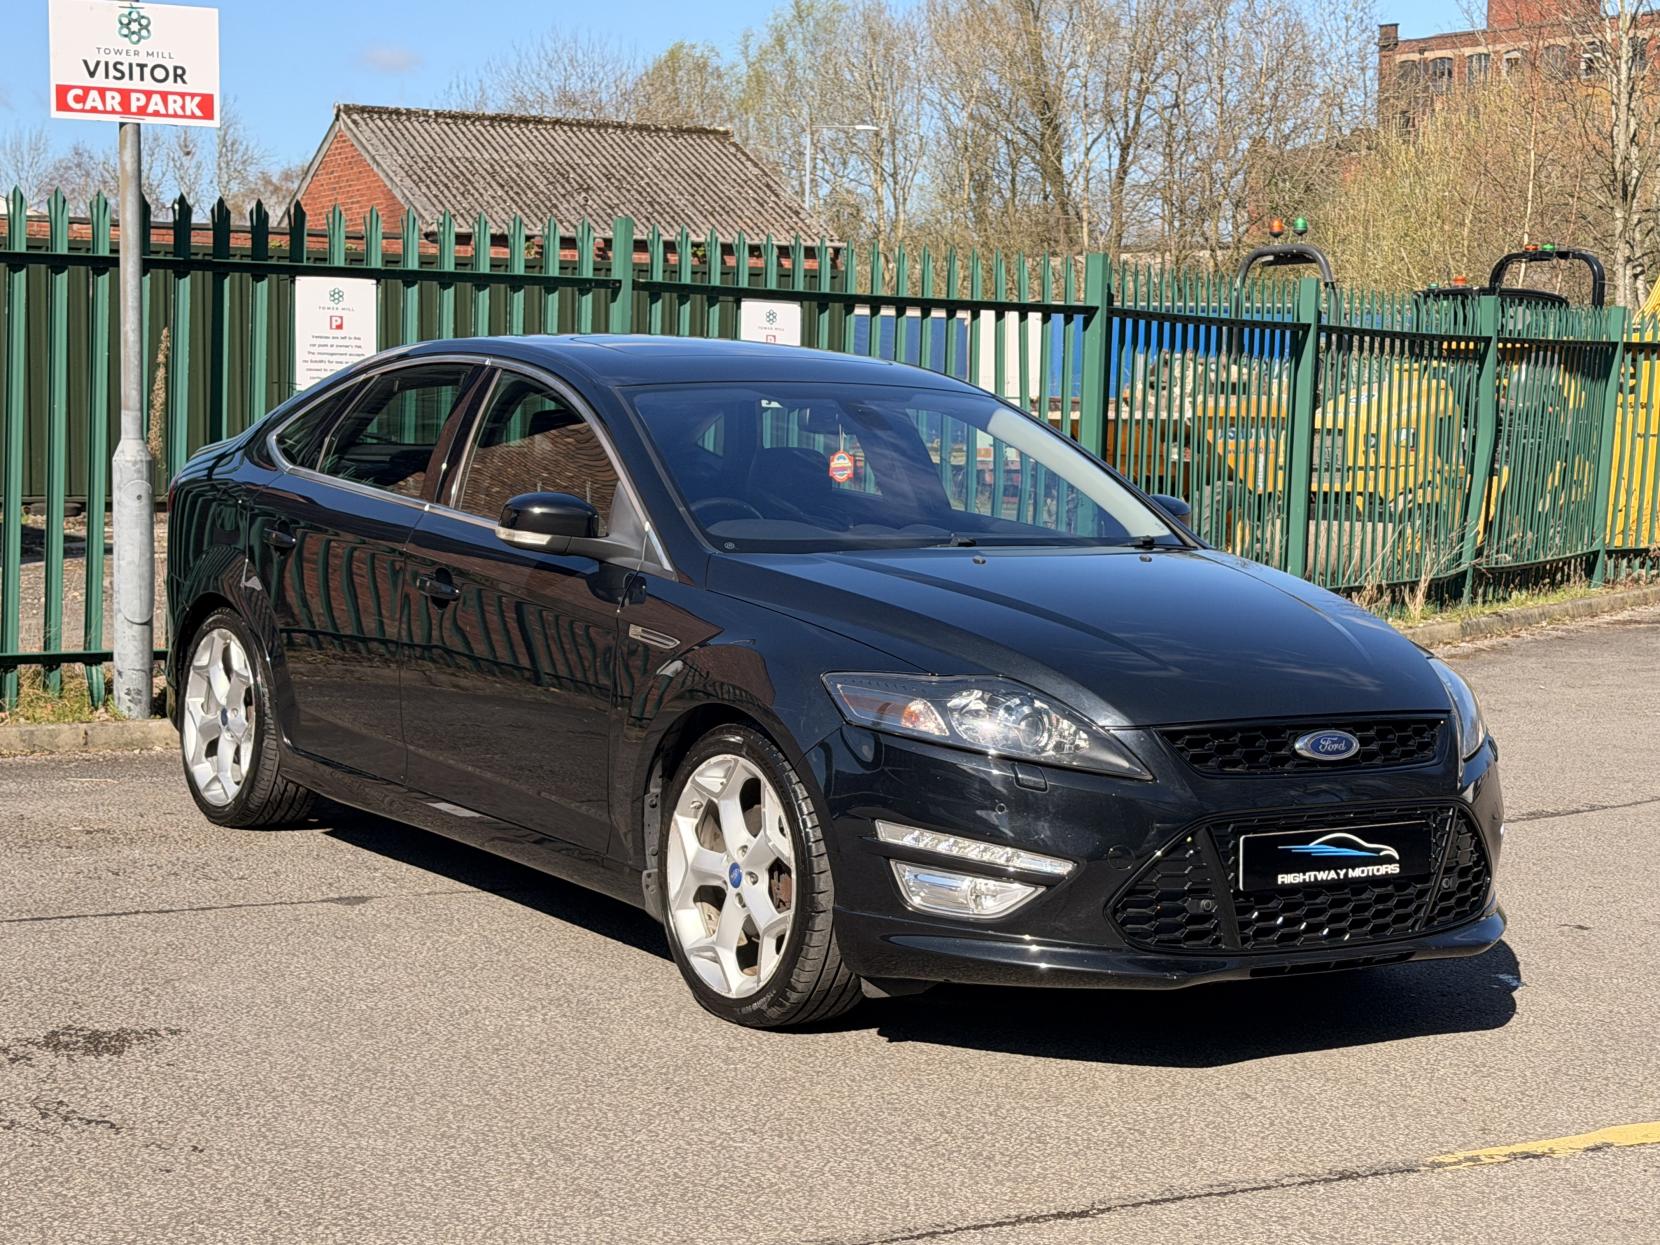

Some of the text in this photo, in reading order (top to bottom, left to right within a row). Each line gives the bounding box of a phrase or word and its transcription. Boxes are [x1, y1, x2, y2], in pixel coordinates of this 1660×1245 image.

[96, 47, 174, 59] TOWER MILL
[82, 59, 188, 85] VISITOR
[66, 88, 203, 117] CAR PARK
[1319, 737, 1347, 752] Ford
[1277, 863, 1400, 885] RIGHTWAY MOTORS
